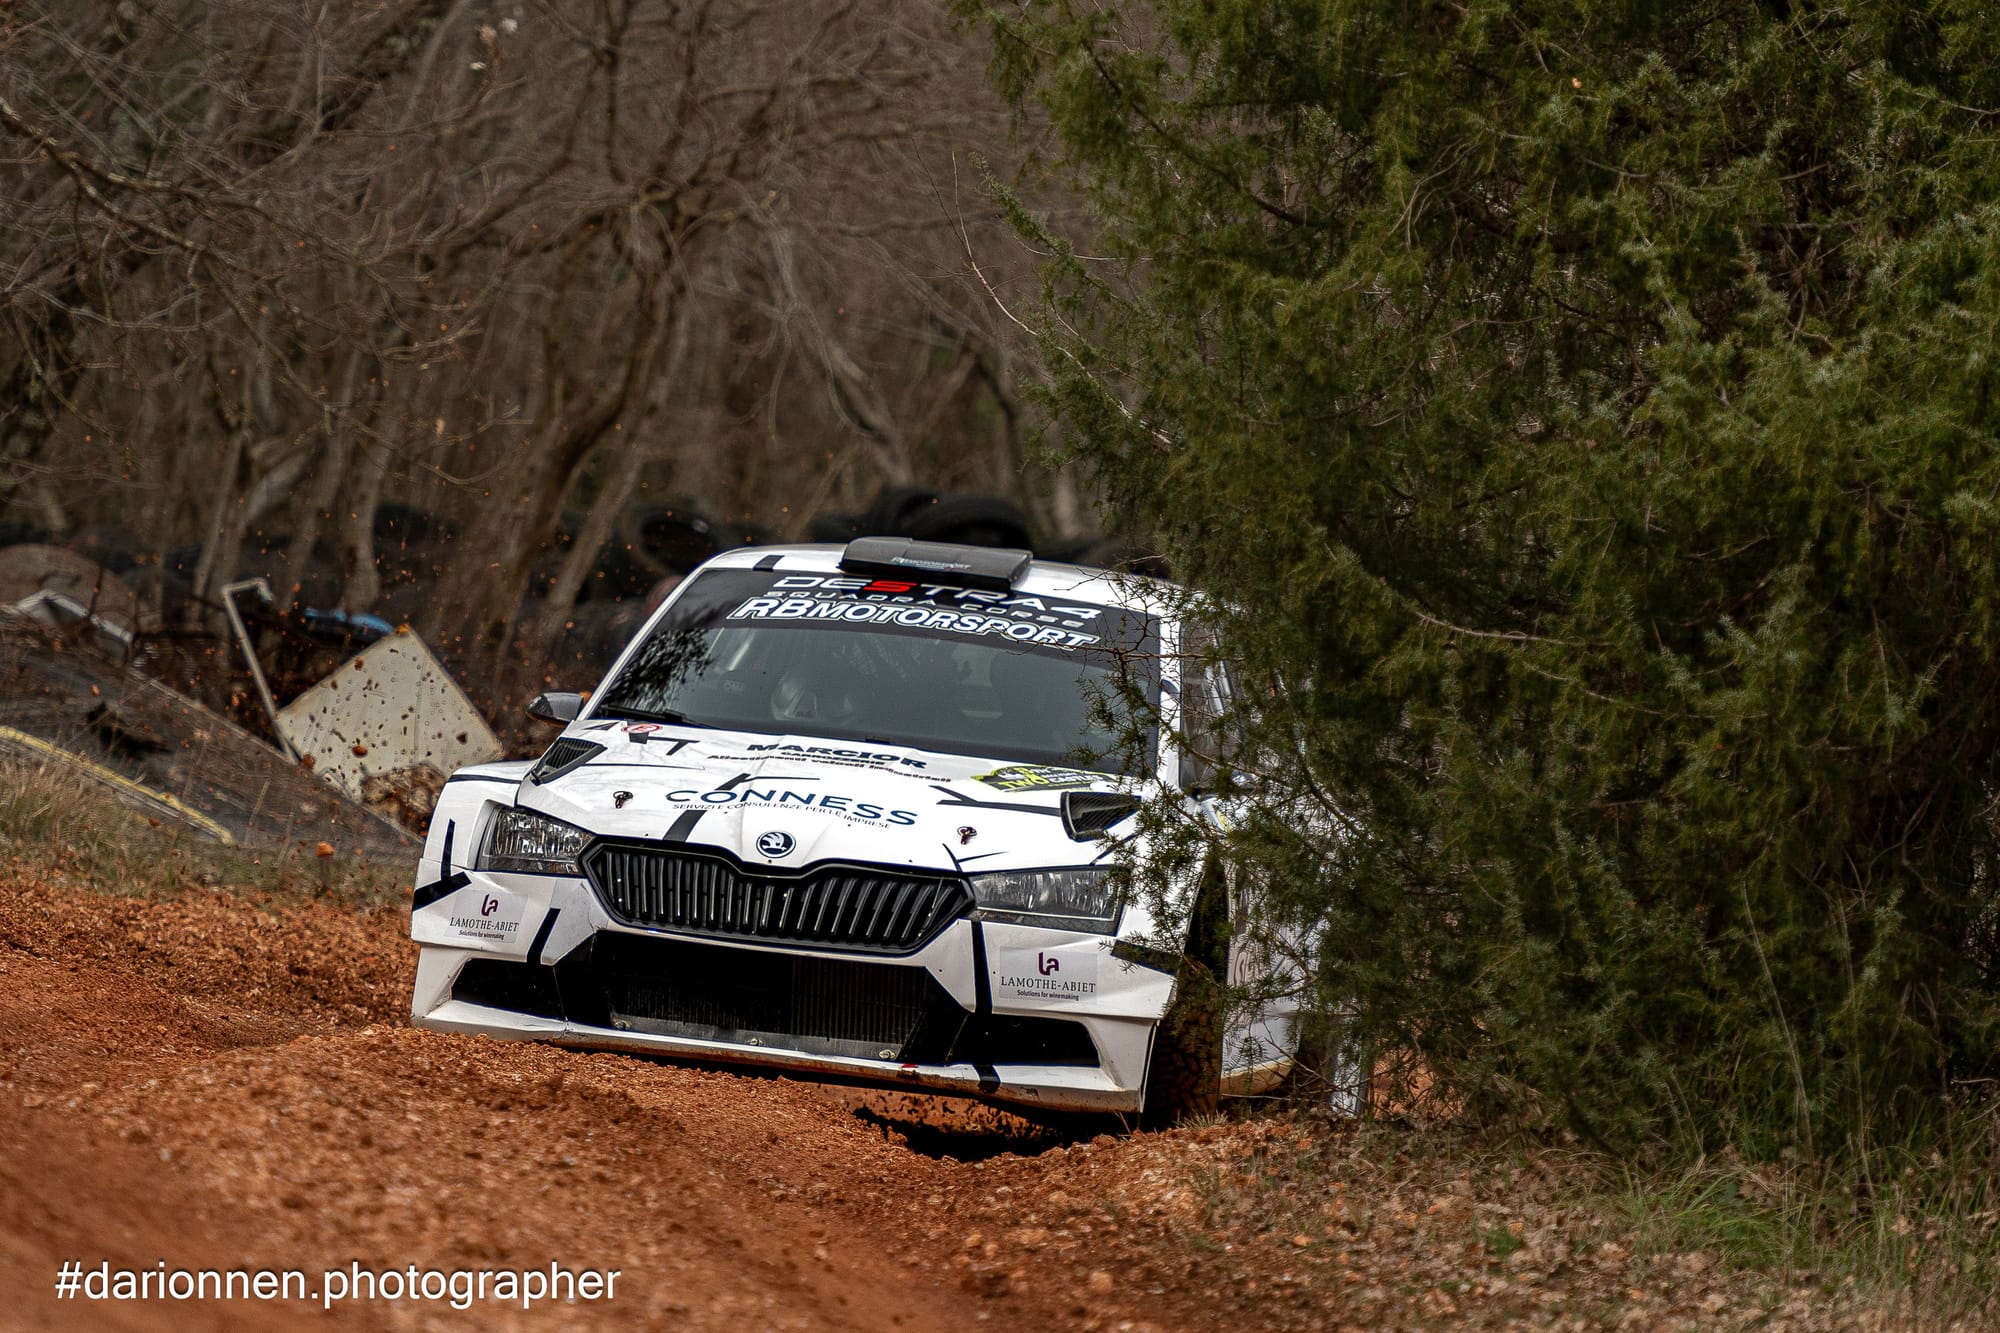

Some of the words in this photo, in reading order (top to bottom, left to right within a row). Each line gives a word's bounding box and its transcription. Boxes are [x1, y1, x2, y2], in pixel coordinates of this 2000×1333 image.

[726, 597, 1101, 651] RBMOTORSPORT
[960, 603, 1085, 628] CORSE
[746, 743, 928, 769] MARCIOR
[665, 789, 919, 826] CONNESS
[727, 802, 803, 811] CONSULENZE
[844, 814, 891, 830] IMPRESE
[449, 916, 520, 932] LAMOTHE-ABIET
[458, 929, 478, 938] Solutions
[1000, 976, 1097, 993] LAMOTHE-ABIET
[1017, 989, 1041, 998] Solutions
[1049, 992, 1080, 1002] winemaking
